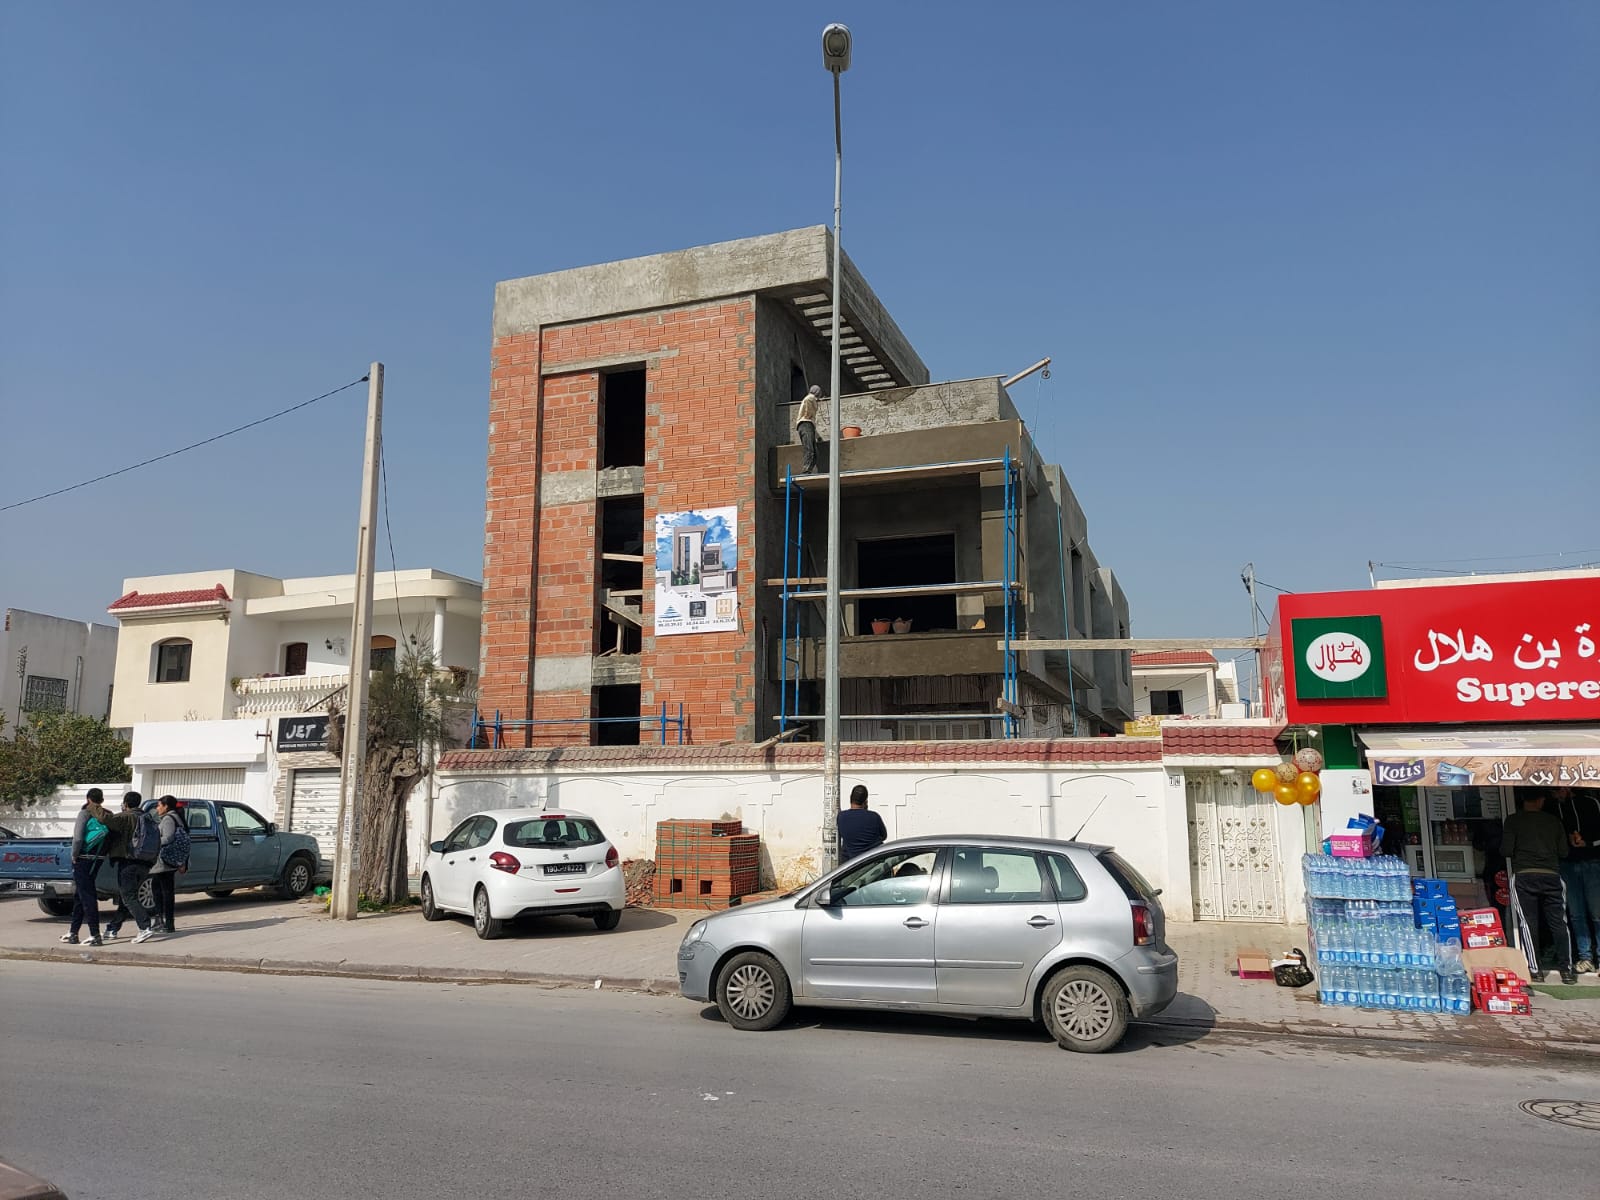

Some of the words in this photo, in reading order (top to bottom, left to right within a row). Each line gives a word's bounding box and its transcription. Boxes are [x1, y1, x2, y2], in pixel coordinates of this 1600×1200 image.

[1315, 643, 1363, 672] هلال
[1337, 640, 1355, 652] بن
[1414, 628, 1494, 672] هلال
[1513, 633, 1562, 670] بن
[1456, 677, 1600, 707] Supere
[286, 724, 317, 740] JET
[1487, 762, 1523, 784] هلال
[1529, 769, 1554, 785] بن
